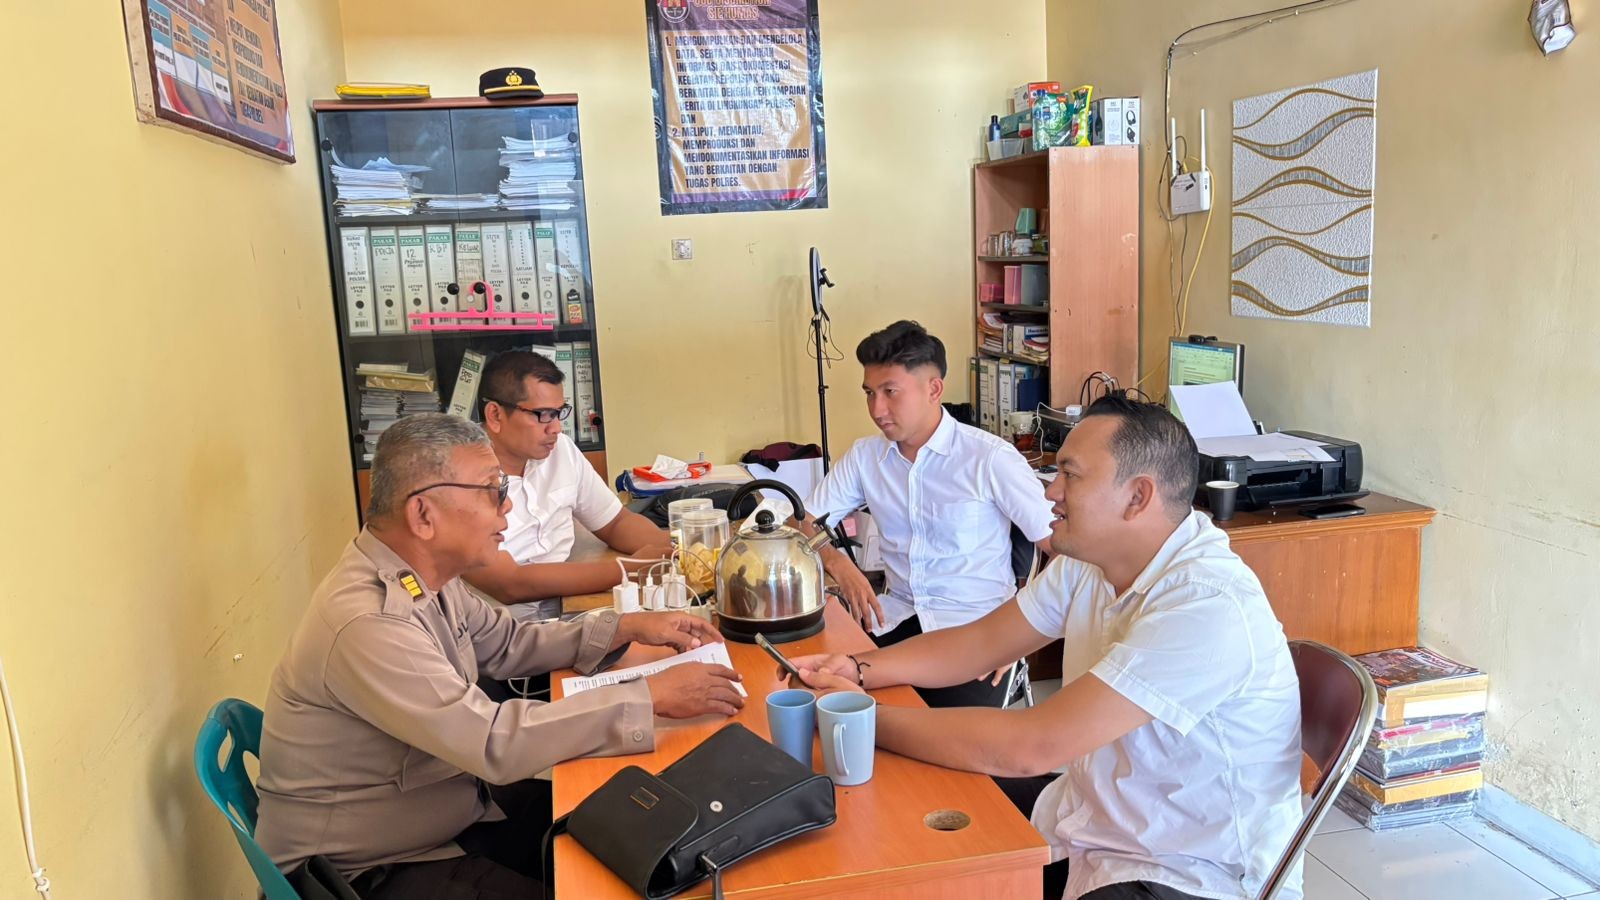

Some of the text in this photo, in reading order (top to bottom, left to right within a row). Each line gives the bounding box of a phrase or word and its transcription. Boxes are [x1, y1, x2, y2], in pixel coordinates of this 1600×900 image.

[708, 7, 723, 19] SIE
[683, 138, 756, 150] MEMPRODUKSI DAN
[684, 148, 810, 162] MENDOKUMENTASIKAN INFORMASI
[685, 162, 778, 175] YANG BERKAITAN DENGAN
[685, 178, 709, 188] TUGAS
